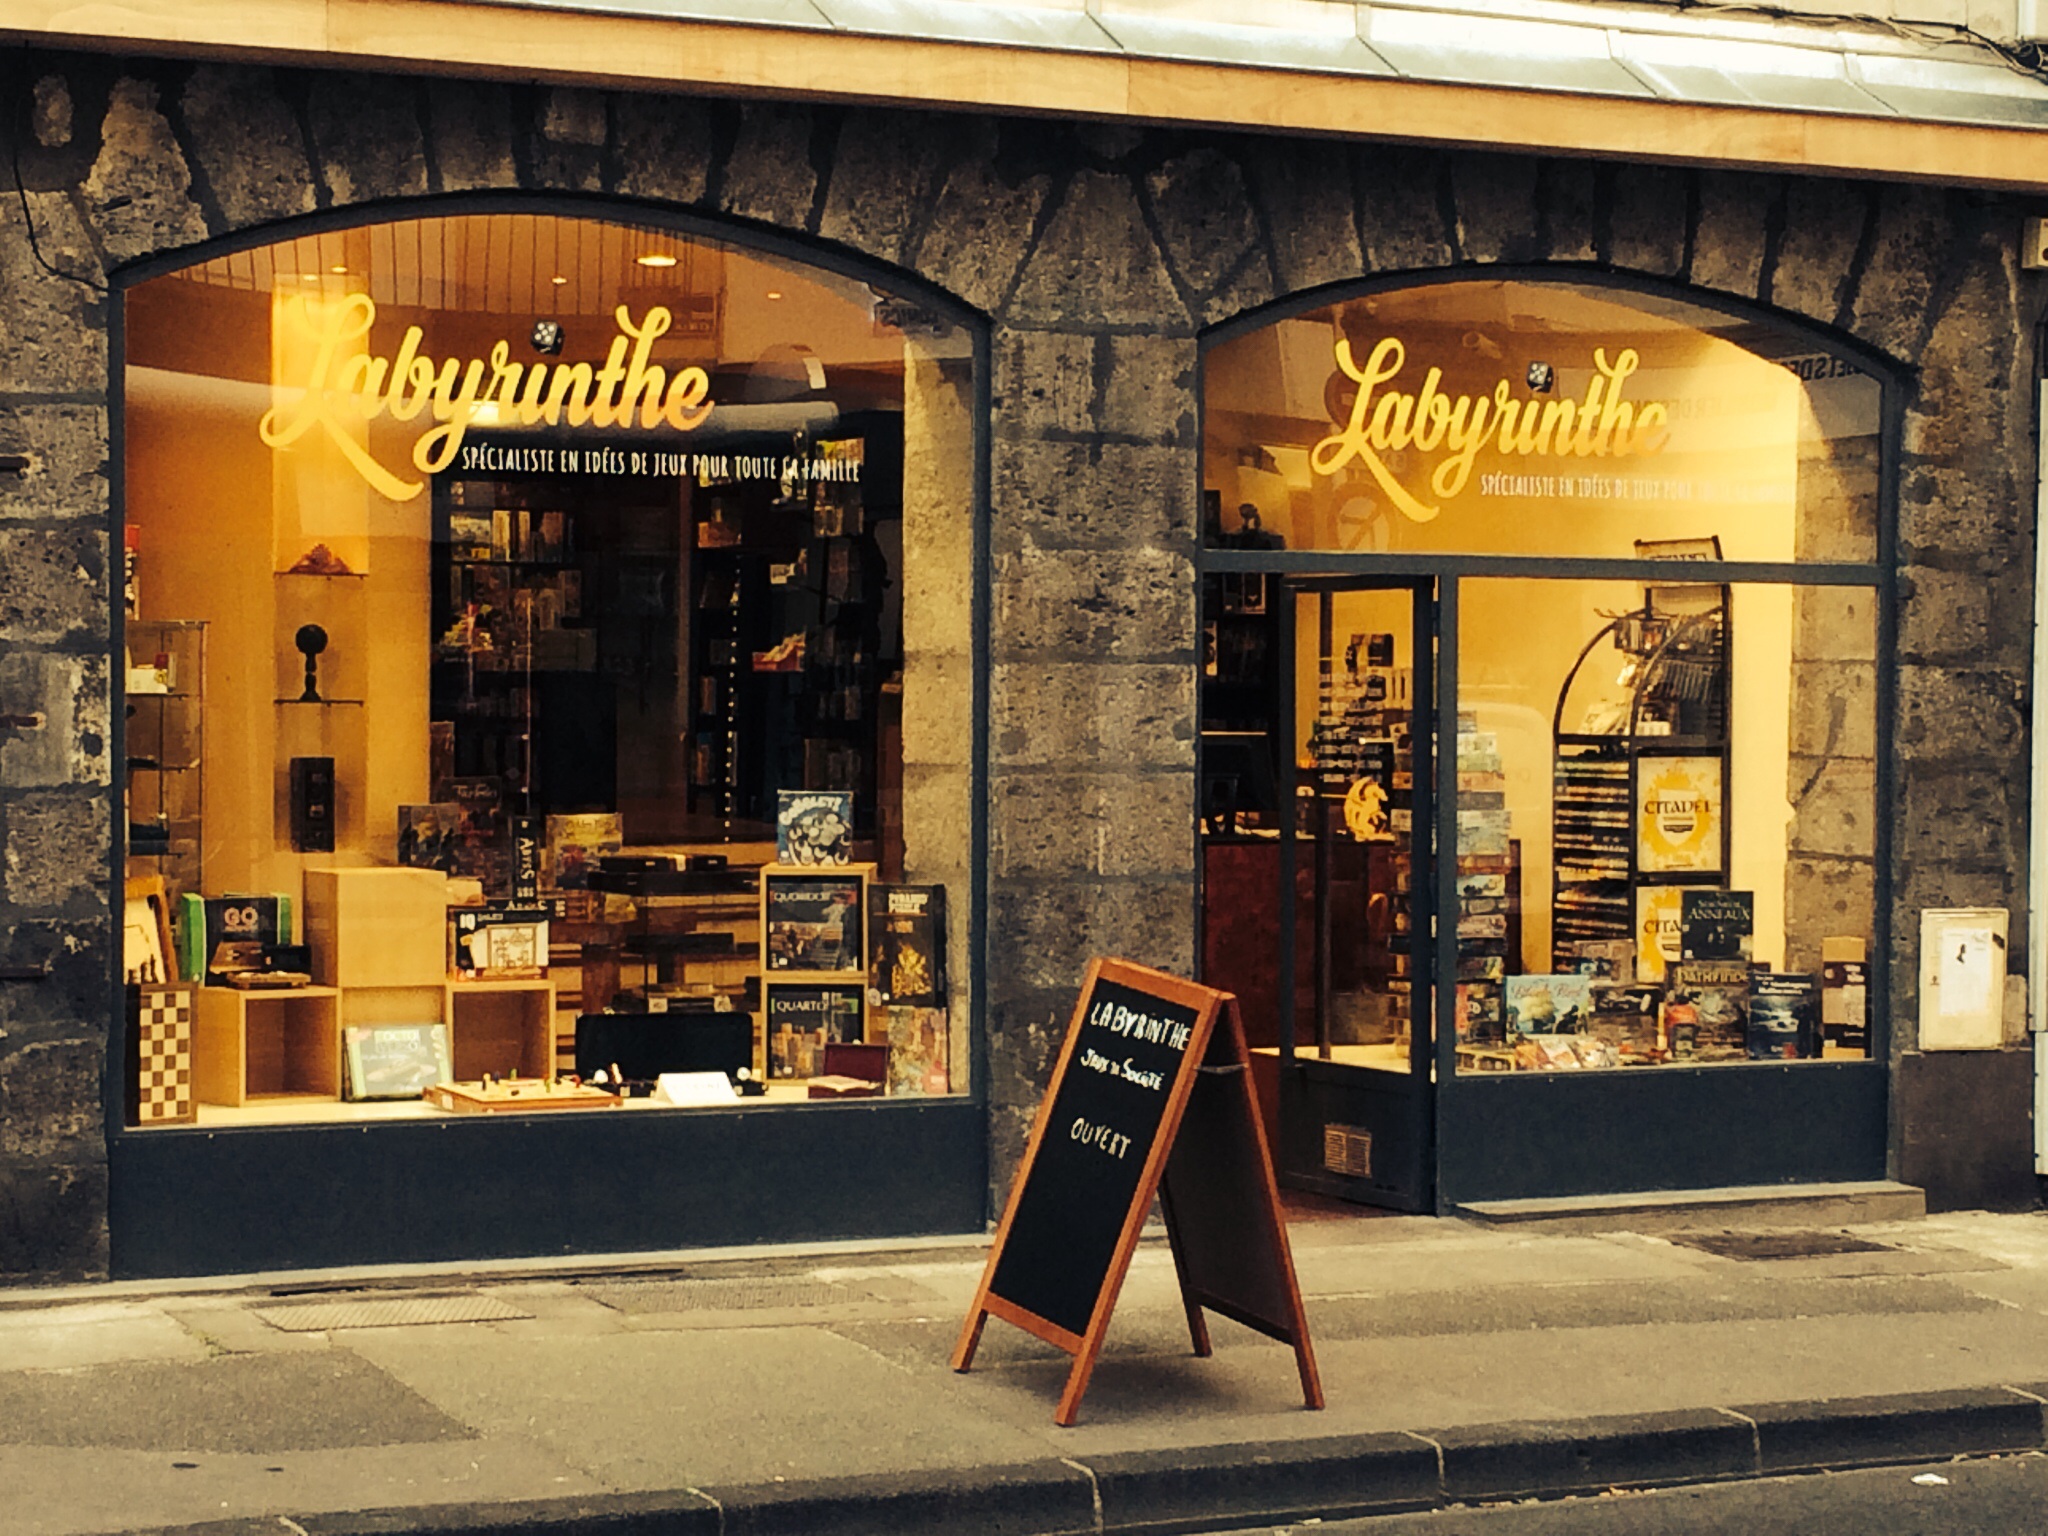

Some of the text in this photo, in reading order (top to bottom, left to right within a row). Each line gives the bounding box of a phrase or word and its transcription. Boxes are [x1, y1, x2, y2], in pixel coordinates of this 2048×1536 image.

[260, 293, 714, 502] Labyrinthe
[1311, 337, 1671, 523] Labyrinthe
[462, 442, 555, 472] SPÉCIALISTE
[560, 449, 579, 473] EN
[584, 447, 626, 474] IDÉES
[631, 452, 648, 475] DE
[653, 452, 688, 477] JEUX
[692, 454, 729, 477] POUR
[735, 456, 777, 480] TOUTE
[802, 458, 860, 482] FAMILLE
[1480, 470, 1556, 497] SPÉCIALISTE
[1558, 475, 1574, 497] EN
[1578, 473, 1611, 499] IDÉES
[1615, 477, 1629, 499] DE
[224, 906, 259, 926] GO
[1091, 1001, 1193, 1051] LABYRINTHE
[1070, 1117, 1132, 1160] OUVERT
